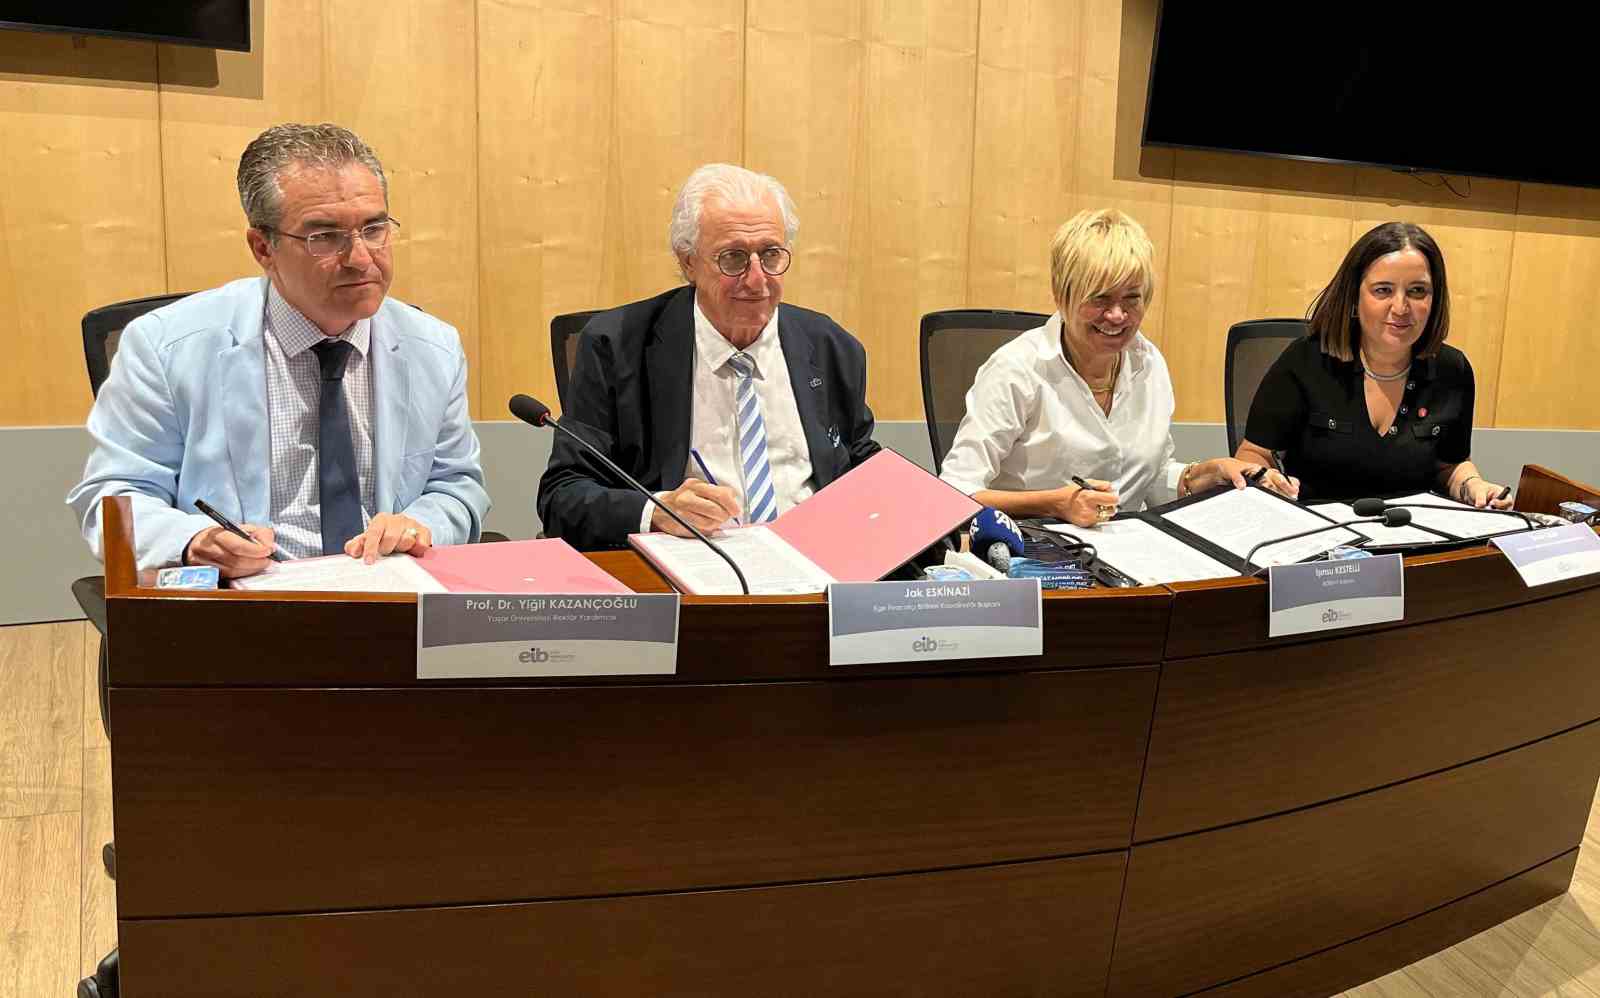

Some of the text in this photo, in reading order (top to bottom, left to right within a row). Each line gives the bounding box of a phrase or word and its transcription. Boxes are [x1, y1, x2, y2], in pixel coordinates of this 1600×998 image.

[904, 588, 924, 598] Jak
[466, 599, 494, 609] Prof.
[498, 599, 514, 610] Dr.
[549, 597, 638, 611] KAZANÇOĞLU
[911, 636, 938, 652] eib
[519, 647, 549, 663] eib
